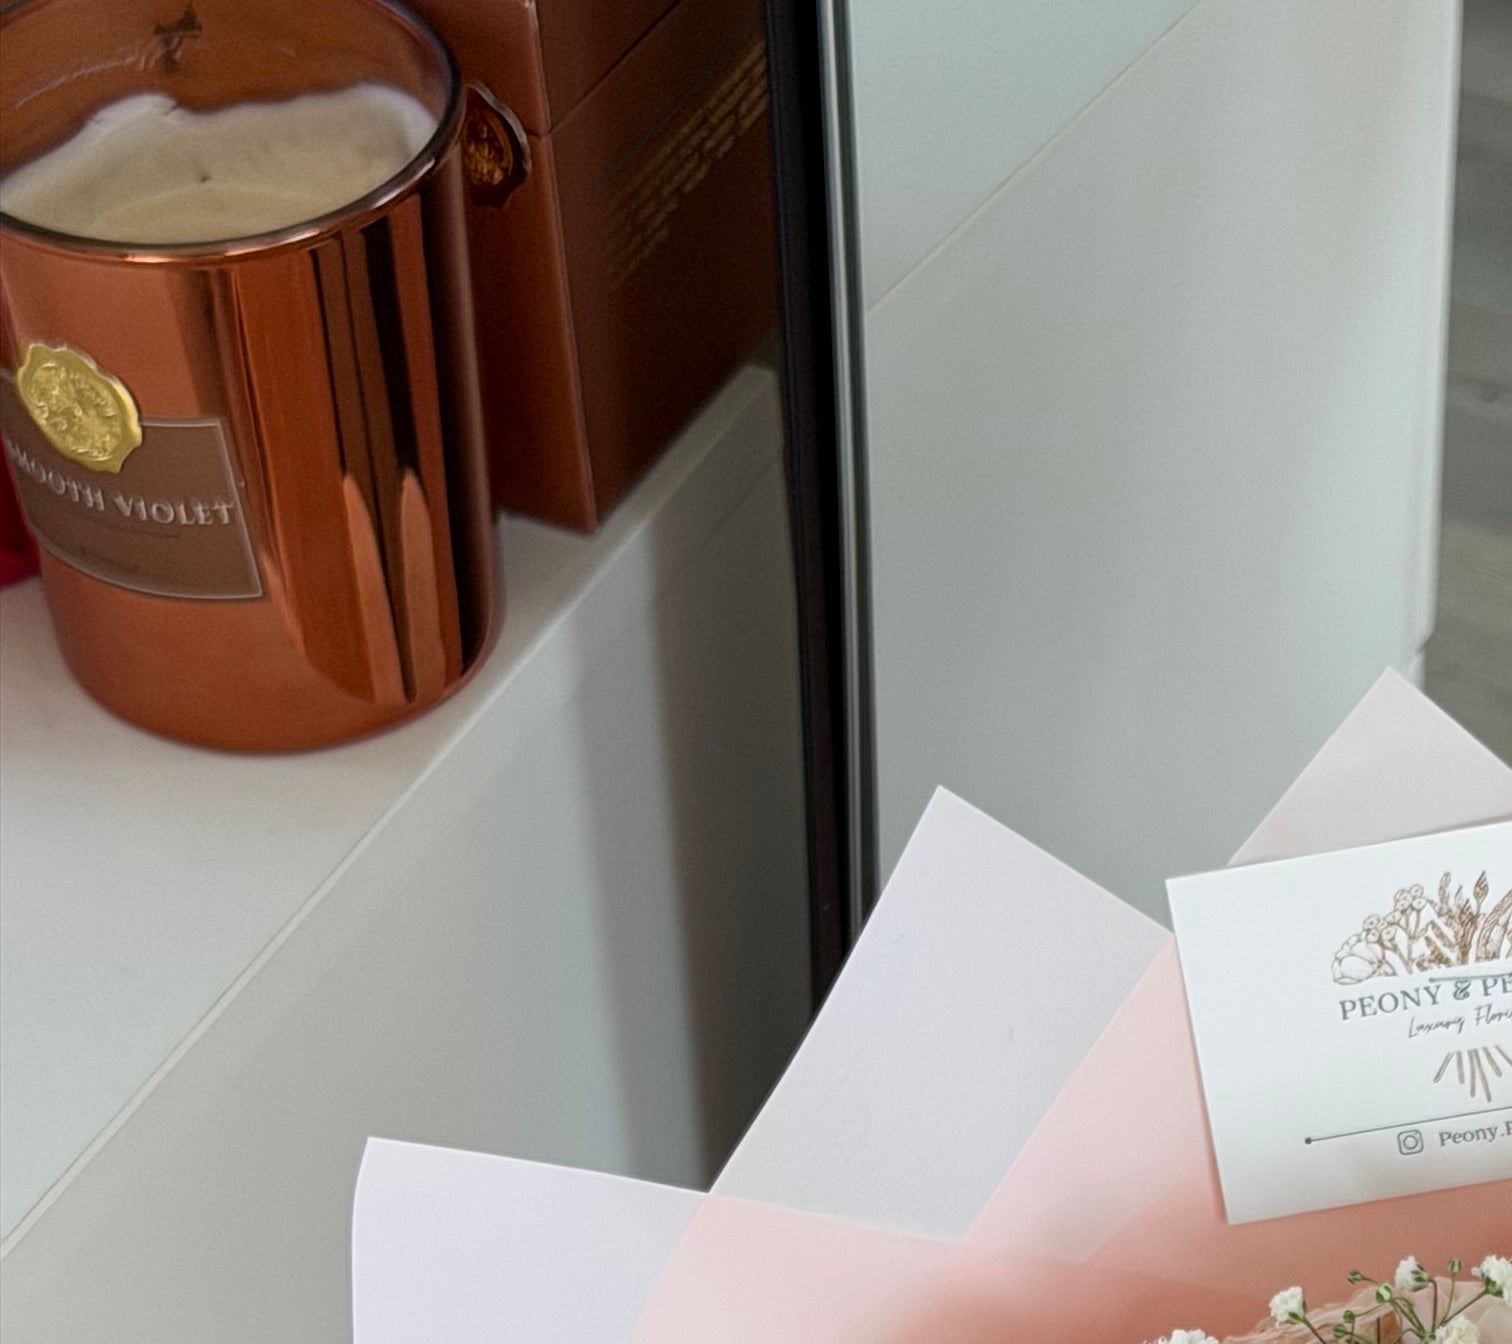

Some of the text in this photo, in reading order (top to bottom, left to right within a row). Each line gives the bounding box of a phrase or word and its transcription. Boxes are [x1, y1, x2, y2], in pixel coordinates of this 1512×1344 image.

[113, 493, 235, 526] VIOLET
[1339, 984, 1442, 1021] PEONY
[1452, 979, 1472, 1001] &
